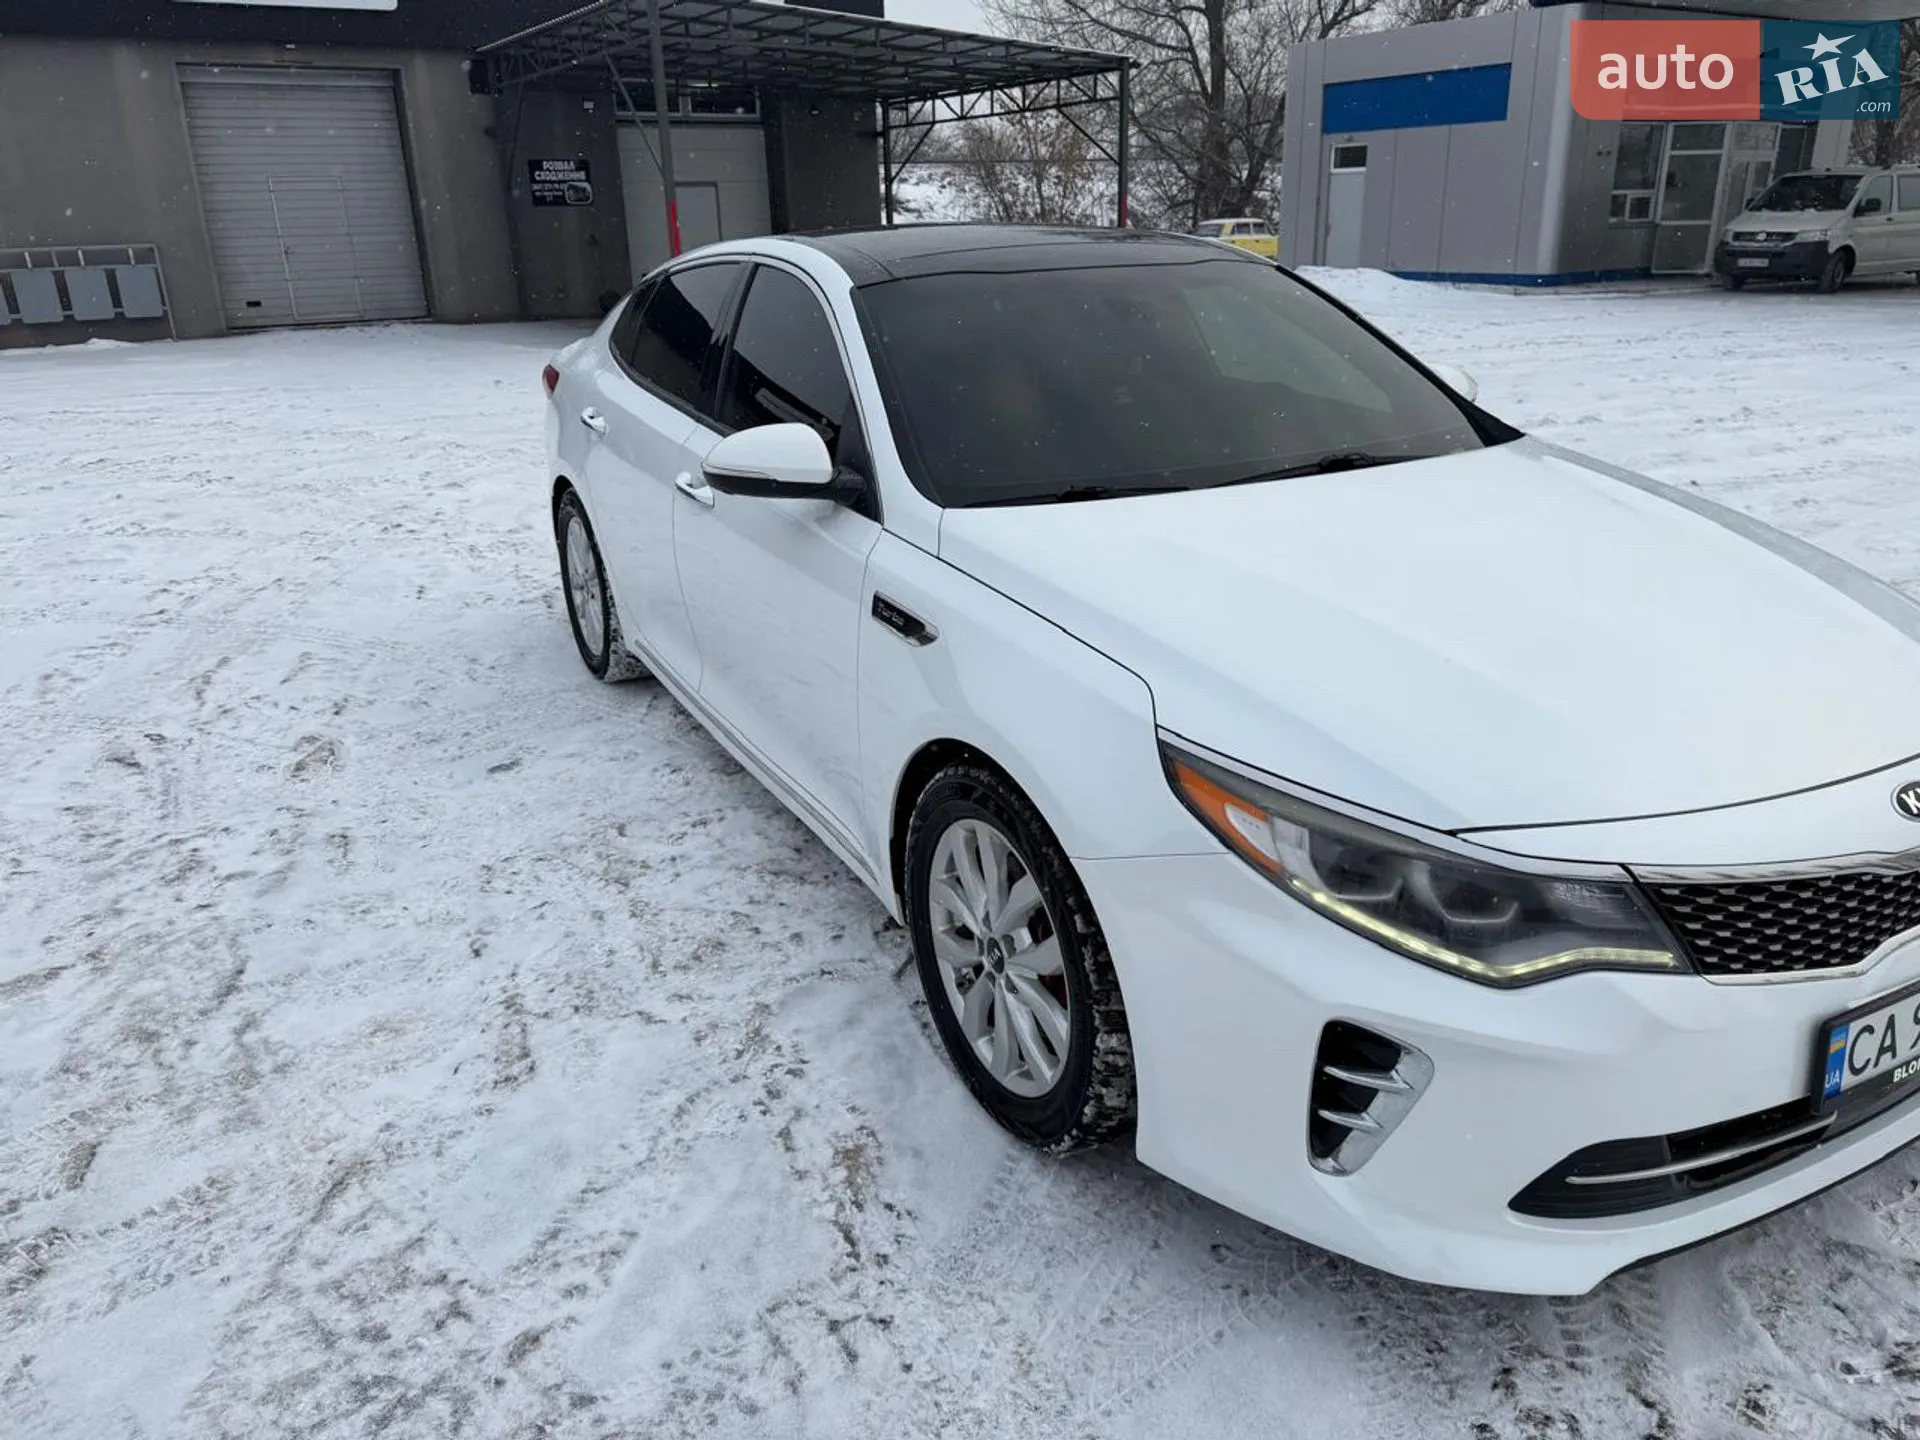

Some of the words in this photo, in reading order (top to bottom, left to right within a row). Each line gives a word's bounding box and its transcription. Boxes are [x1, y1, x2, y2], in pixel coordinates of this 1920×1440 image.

[1899, 787, 1920, 815] K
[1848, 1013, 1897, 1076] CA
[1825, 1069, 1841, 1088] UA
